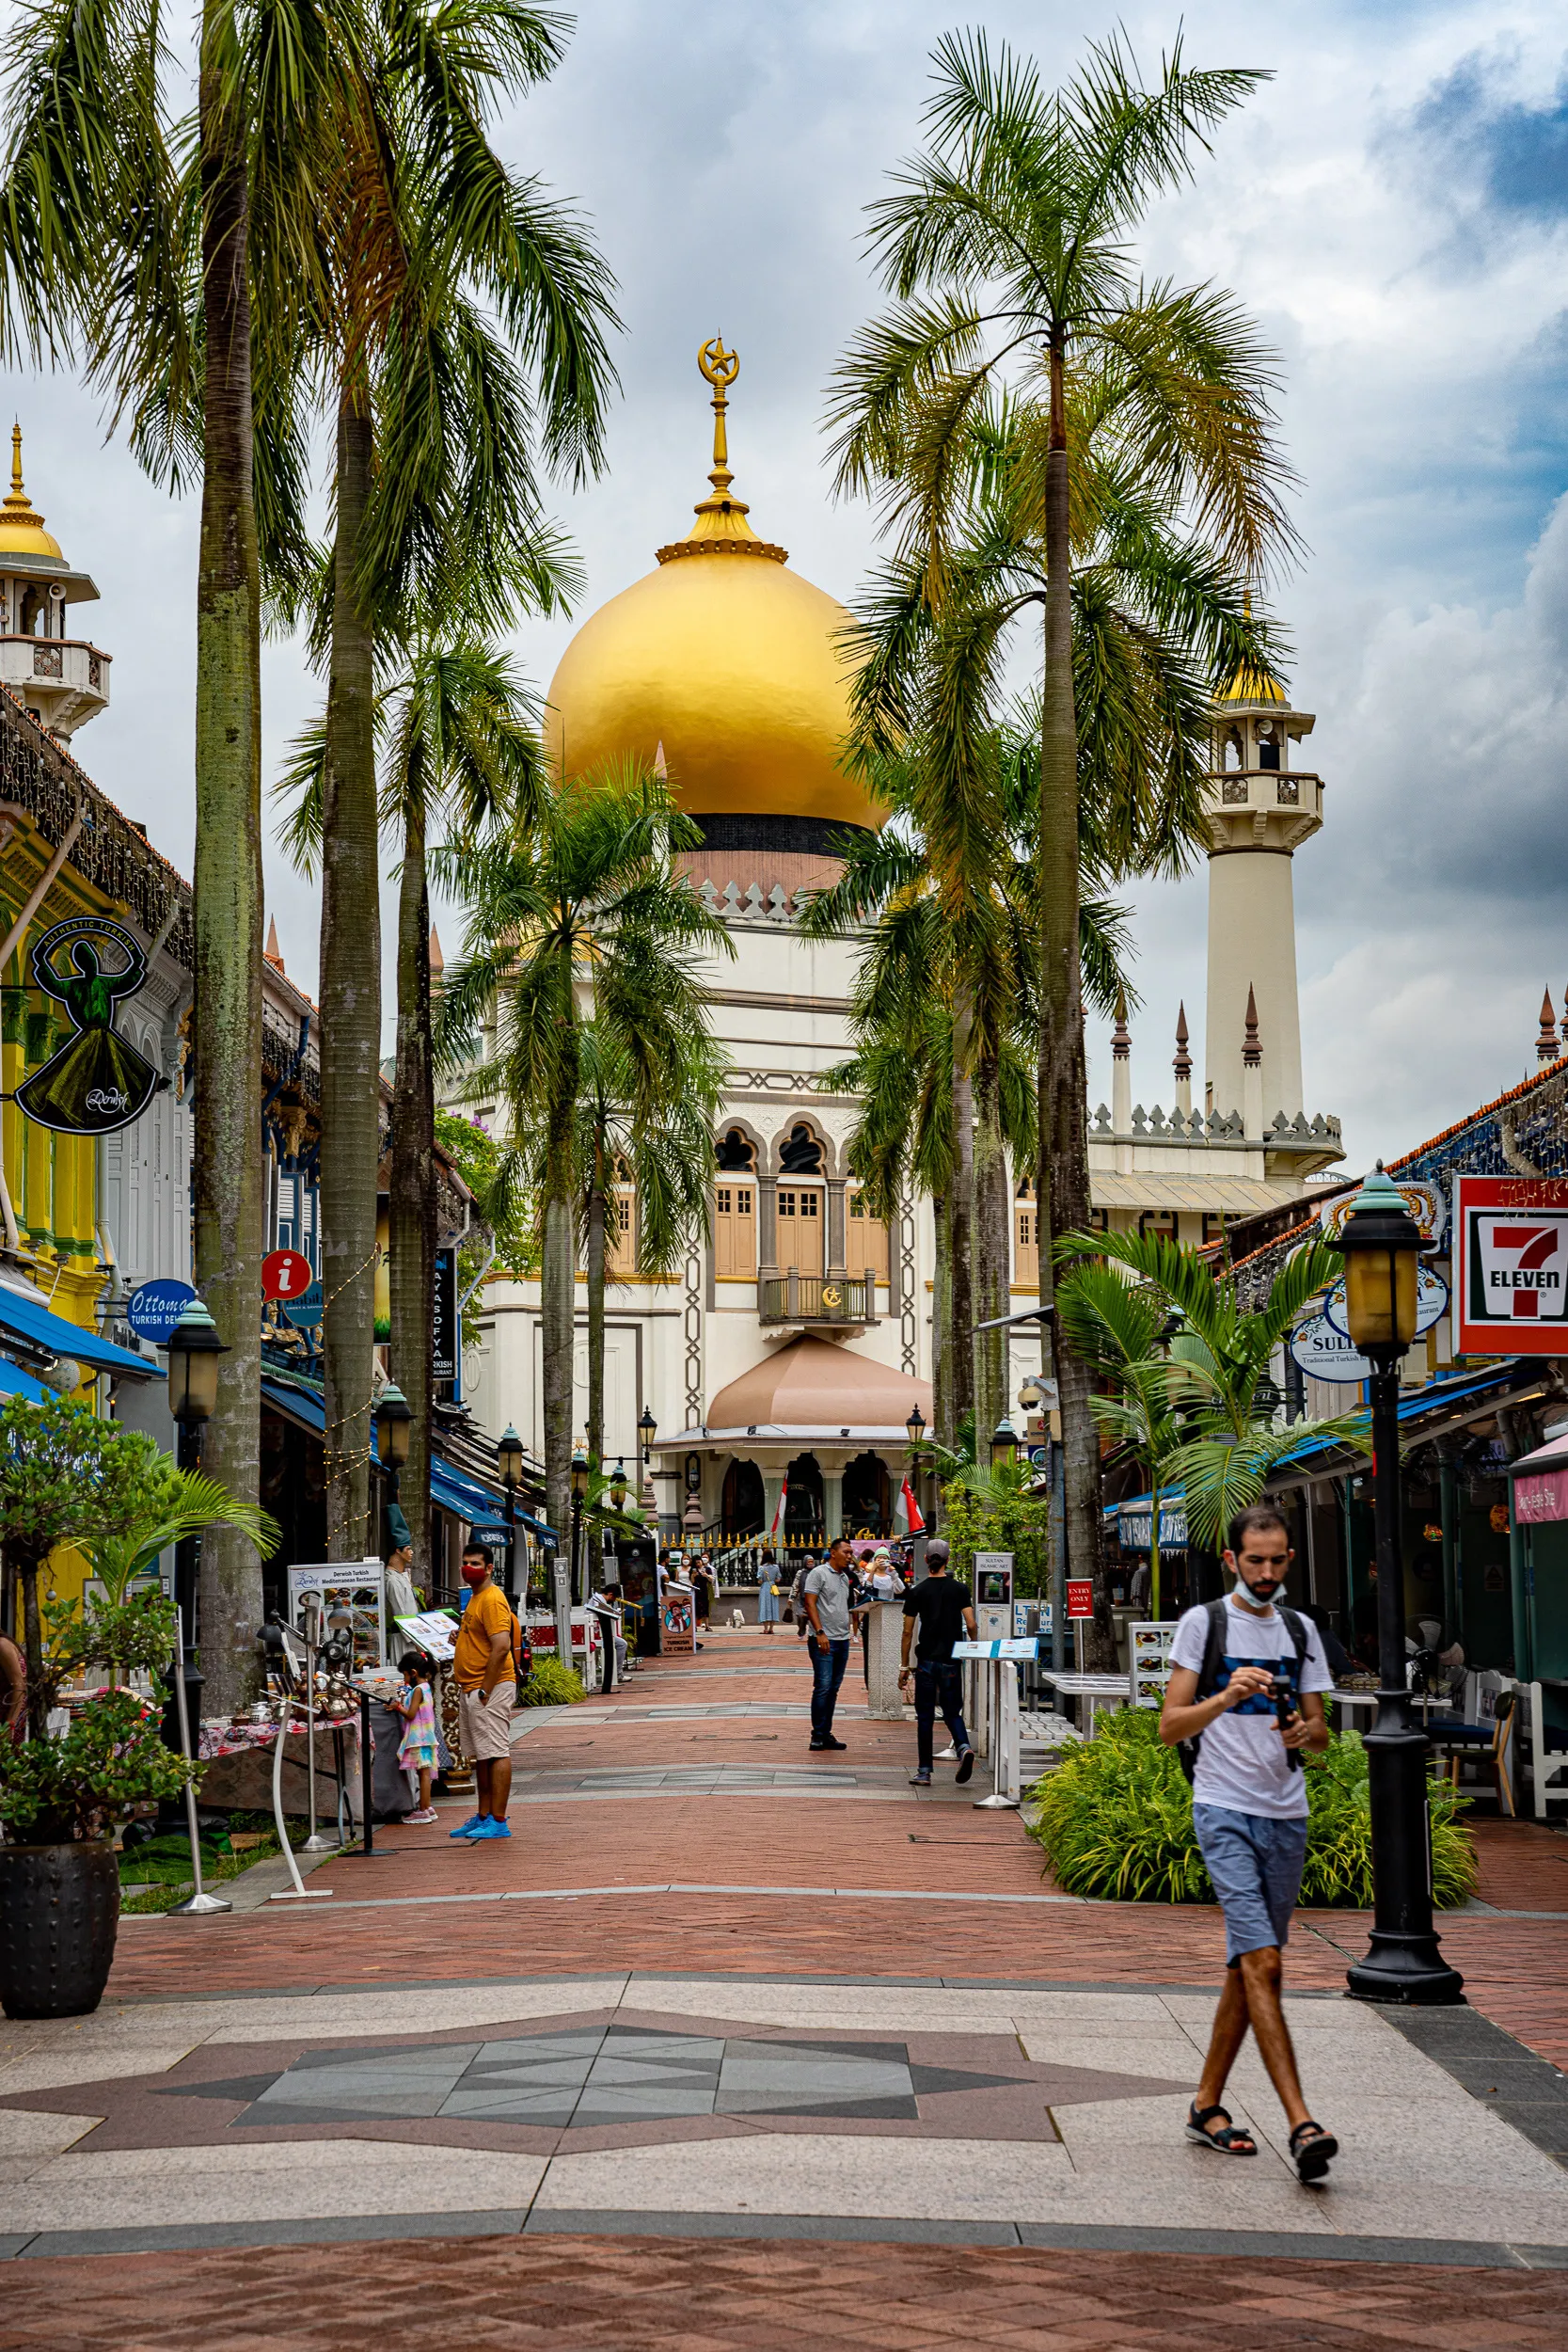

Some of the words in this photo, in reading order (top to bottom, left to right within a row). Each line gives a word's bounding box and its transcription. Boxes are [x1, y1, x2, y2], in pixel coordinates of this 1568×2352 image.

[44, 921, 94, 947] AUTHENTIC
[100, 922, 135, 951] TURKISH
[1493, 1227, 1558, 1317] 7
[132, 1291, 187, 1312] Ottoma
[132, 1315, 162, 1325] TURKISH
[434, 1272, 442, 1358] AYASOFYA
[1313, 1336, 1357, 1351] SULT
[1303, 1356, 1335, 1364] Traditional
[1336, 1354, 1359, 1363] Turkish
